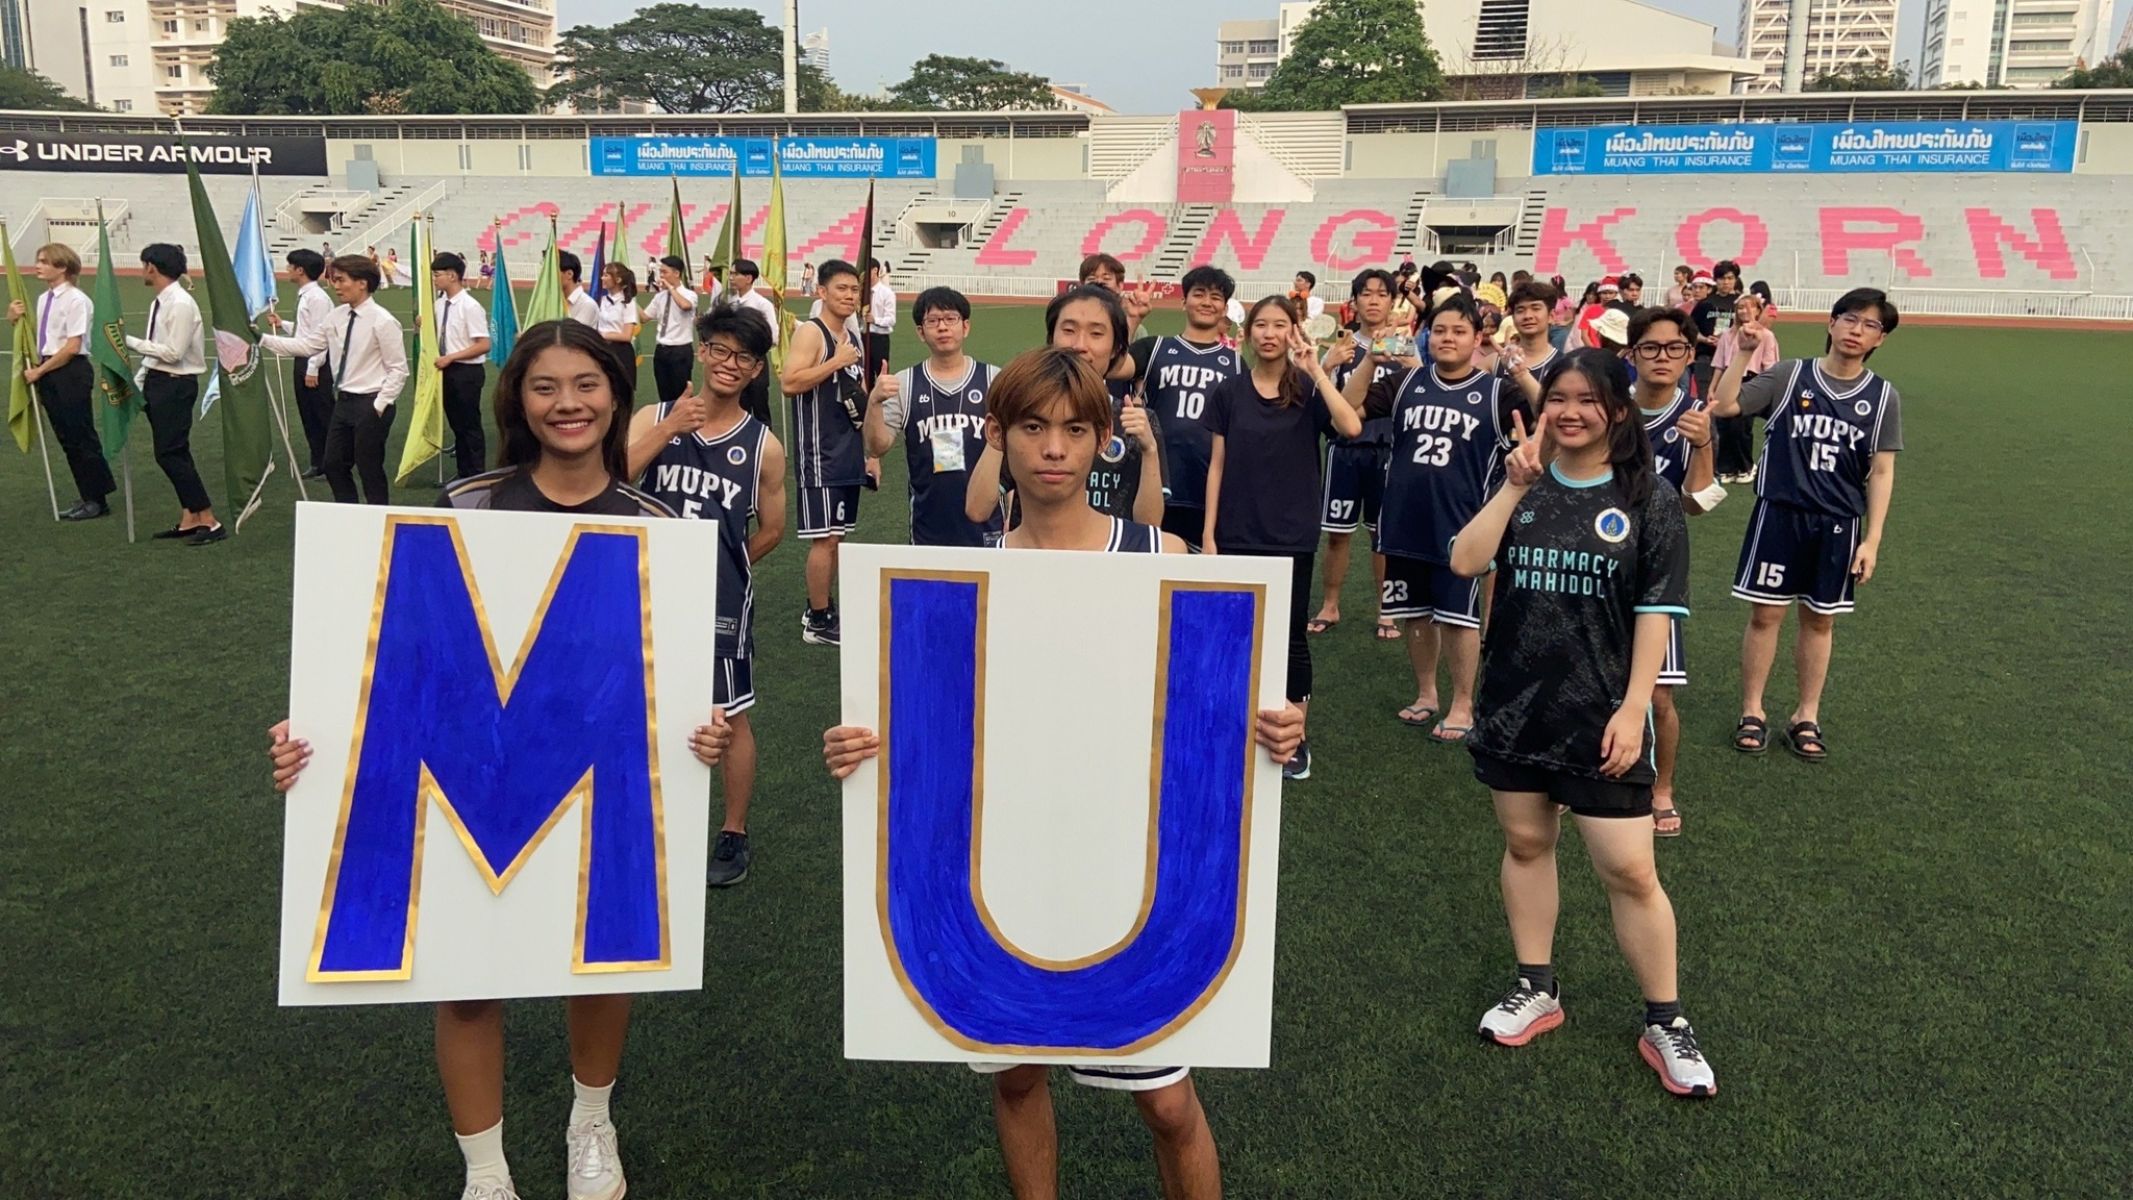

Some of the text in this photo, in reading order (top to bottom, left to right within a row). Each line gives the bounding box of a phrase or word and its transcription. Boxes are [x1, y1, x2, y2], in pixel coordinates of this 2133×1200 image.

[1605, 131, 1754, 152] เมืองไทยประกันภัย
[1832, 128, 1993, 150] เมืองไทยประกันภัย
[37, 143, 272, 164] UNDER ARMOUR
[637, 162, 734, 171] MUANG THAI INSURANCE
[1604, 155, 1752, 167] MUANG THAI INSURANCE
[1830, 153, 1990, 165] MUANG THAI INSURANCE
[782, 163, 884, 172] MUANG THAI INSURANCE
[1176, 390, 1205, 420] 10
[1403, 405, 1480, 441] MUPY
[1791, 414, 1865, 451] MUPY
[1412, 433, 1453, 467] 23
[1809, 442, 1840, 472] 15
[655, 464, 742, 510] MUPY
[836, 501, 845, 521] 6
[1330, 499, 1355, 520] 97
[1508, 546, 1619, 578] PHARMACY
[1756, 561, 1786, 588] 15
[1382, 580, 1409, 603] 23
[1515, 569, 1605, 598] MAHIDOL
[306, 514, 671, 983] M
[875, 567, 1267, 1057] U
